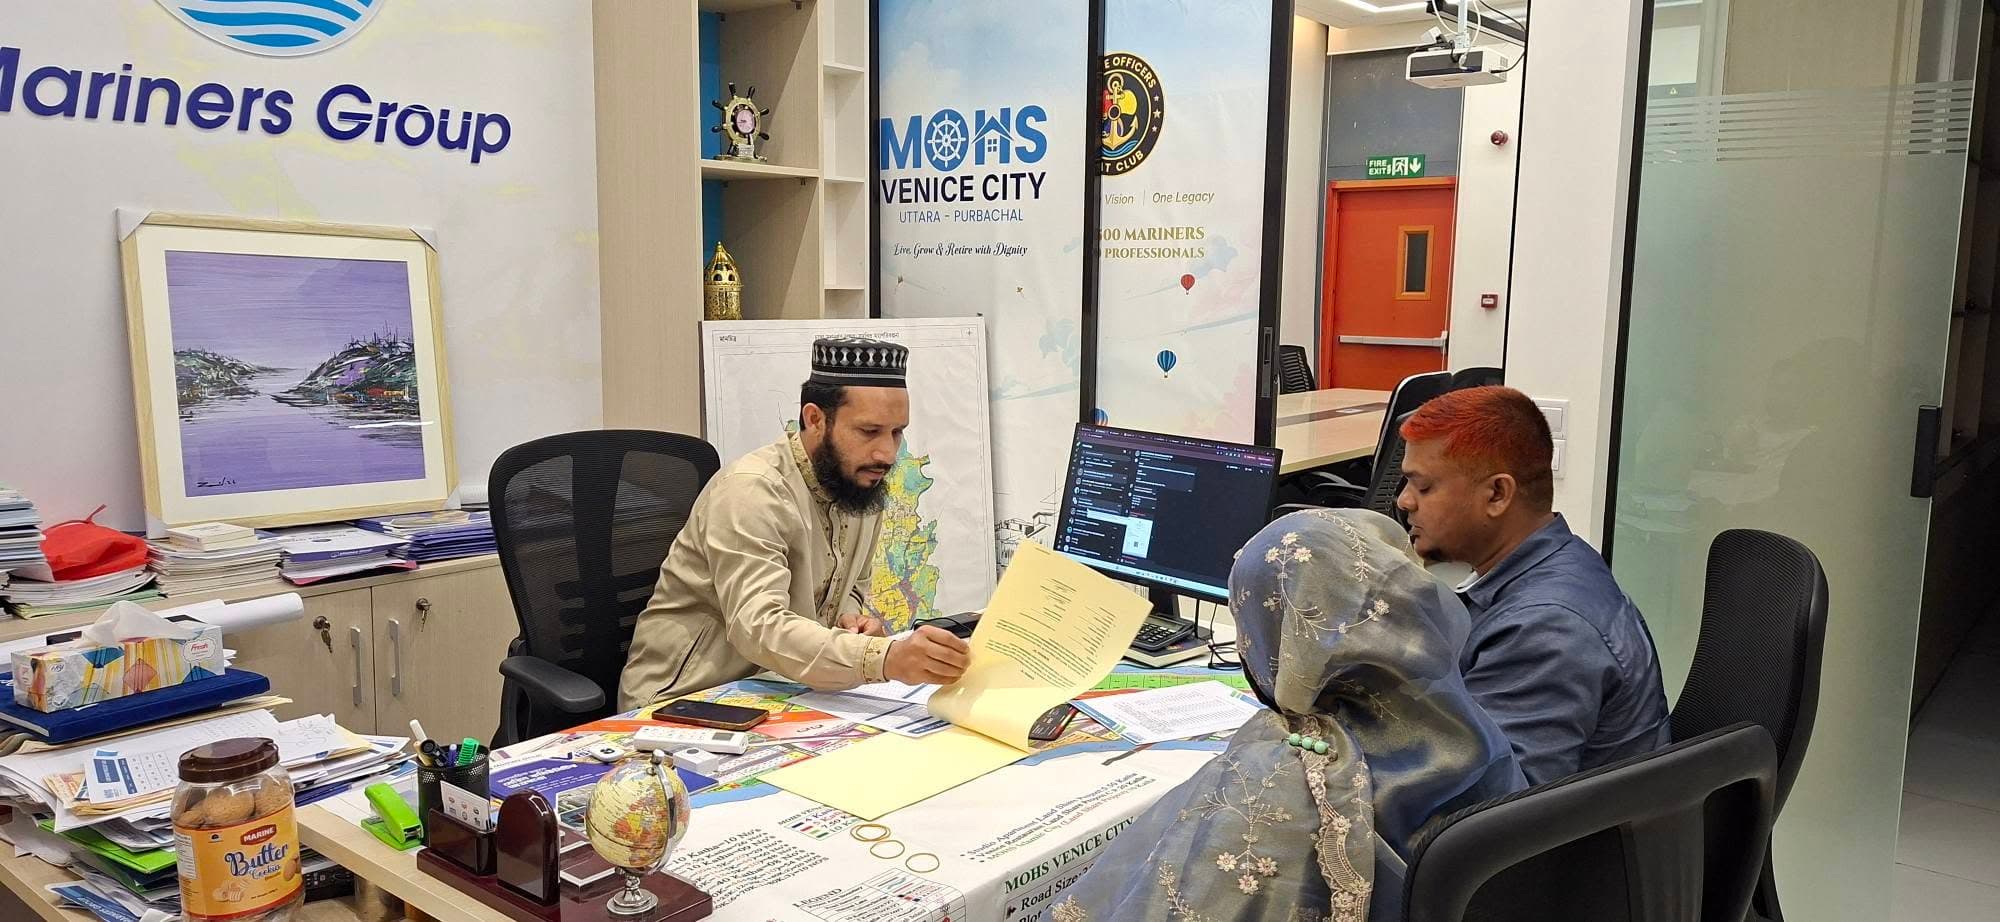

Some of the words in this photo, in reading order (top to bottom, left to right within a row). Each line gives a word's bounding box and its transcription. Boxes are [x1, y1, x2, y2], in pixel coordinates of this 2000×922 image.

[1112, 56, 1157, 89] OFFICERS
[316, 83, 511, 164] Group
[880, 105, 1048, 172] MOHS
[1115, 150, 1144, 171] CLUB
[881, 175, 974, 204] VENICE
[982, 172, 1046, 201] CITY
[1105, 194, 1134, 205] Vision
[1152, 192, 1173, 203] One
[1175, 191, 1215, 204] Legacy
[899, 211, 941, 223] UTTARA
[954, 208, 1024, 222] PURBACHAL
[1124, 226, 1205, 241] MARINERS
[913, 243, 935, 259] Grow
[945, 242, 973, 255] Retire
[974, 243, 991, 255] with
[992, 241, 1028, 257] Dignity
[1104, 247, 1205, 259] PROFESSIONALS
[243, 827, 275, 842] MARINE
[224, 843, 289, 877] Butter
[1004, 861, 1050, 894] MOHS
[1052, 833, 1102, 869] VENICE
[1020, 885, 1052, 911] Road
